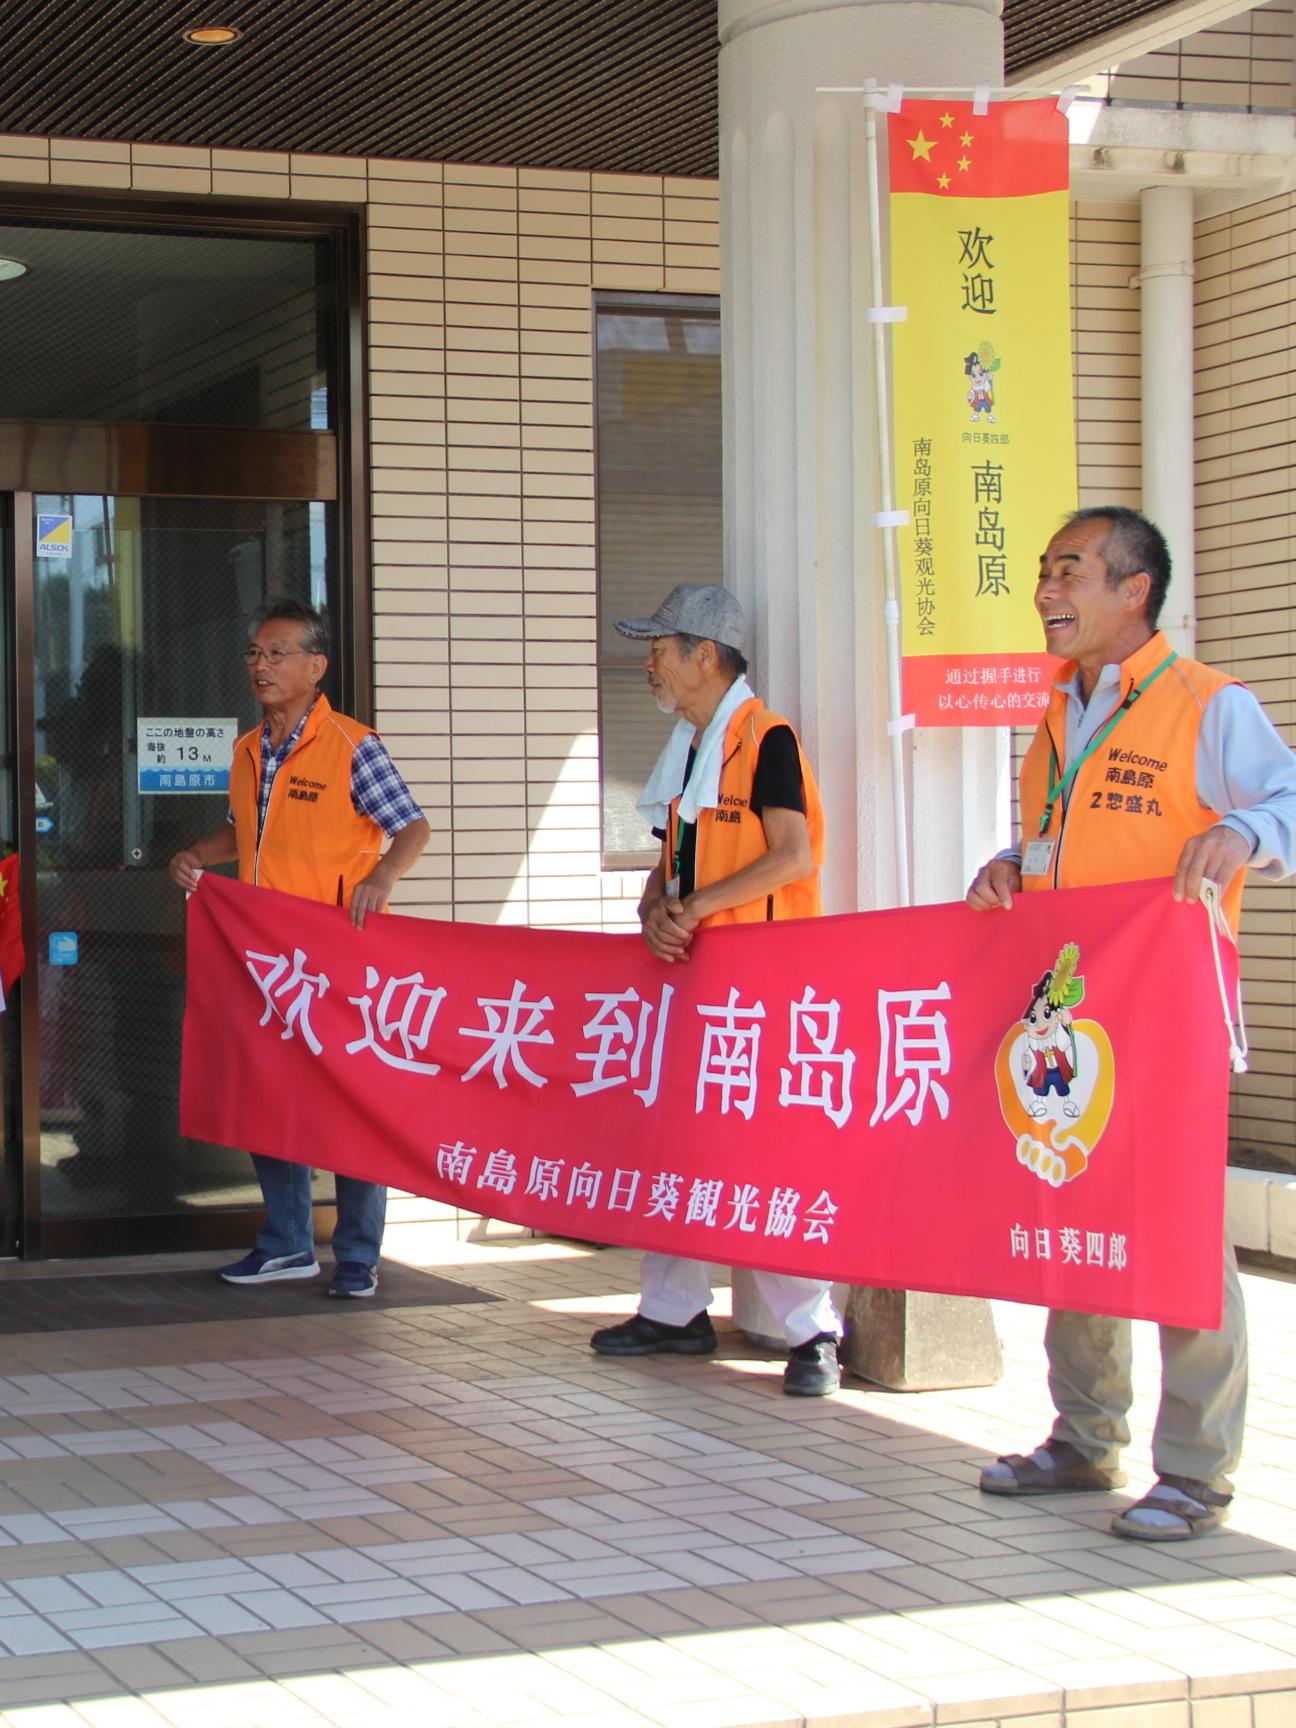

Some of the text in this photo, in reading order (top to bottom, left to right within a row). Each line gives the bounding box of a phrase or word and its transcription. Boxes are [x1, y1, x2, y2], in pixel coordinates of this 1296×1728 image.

[957, 226, 997, 315] 欢迎
[912, 437, 936, 637] 南岛原向日葵观光协会
[970, 459, 1011, 598] 南岛原
[39, 543, 70, 552] ALSOK
[945, 667, 1041, 685] 通过握手进行
[145, 727, 225, 739] ここの地盤の高さ
[177, 746, 199, 761] 13
[1108, 747, 1168, 772] Welcome
[159, 774, 215, 787] 南島原市
[289, 775, 327, 791] Welcome
[1105, 766, 1155, 789] 南島原
[245, 947, 952, 1129] 欢迎来到南岛原
[436, 1140, 839, 1245] 南島原向日葵観光協会
[1009, 1222, 1128, 1272] 向日葵四郎
